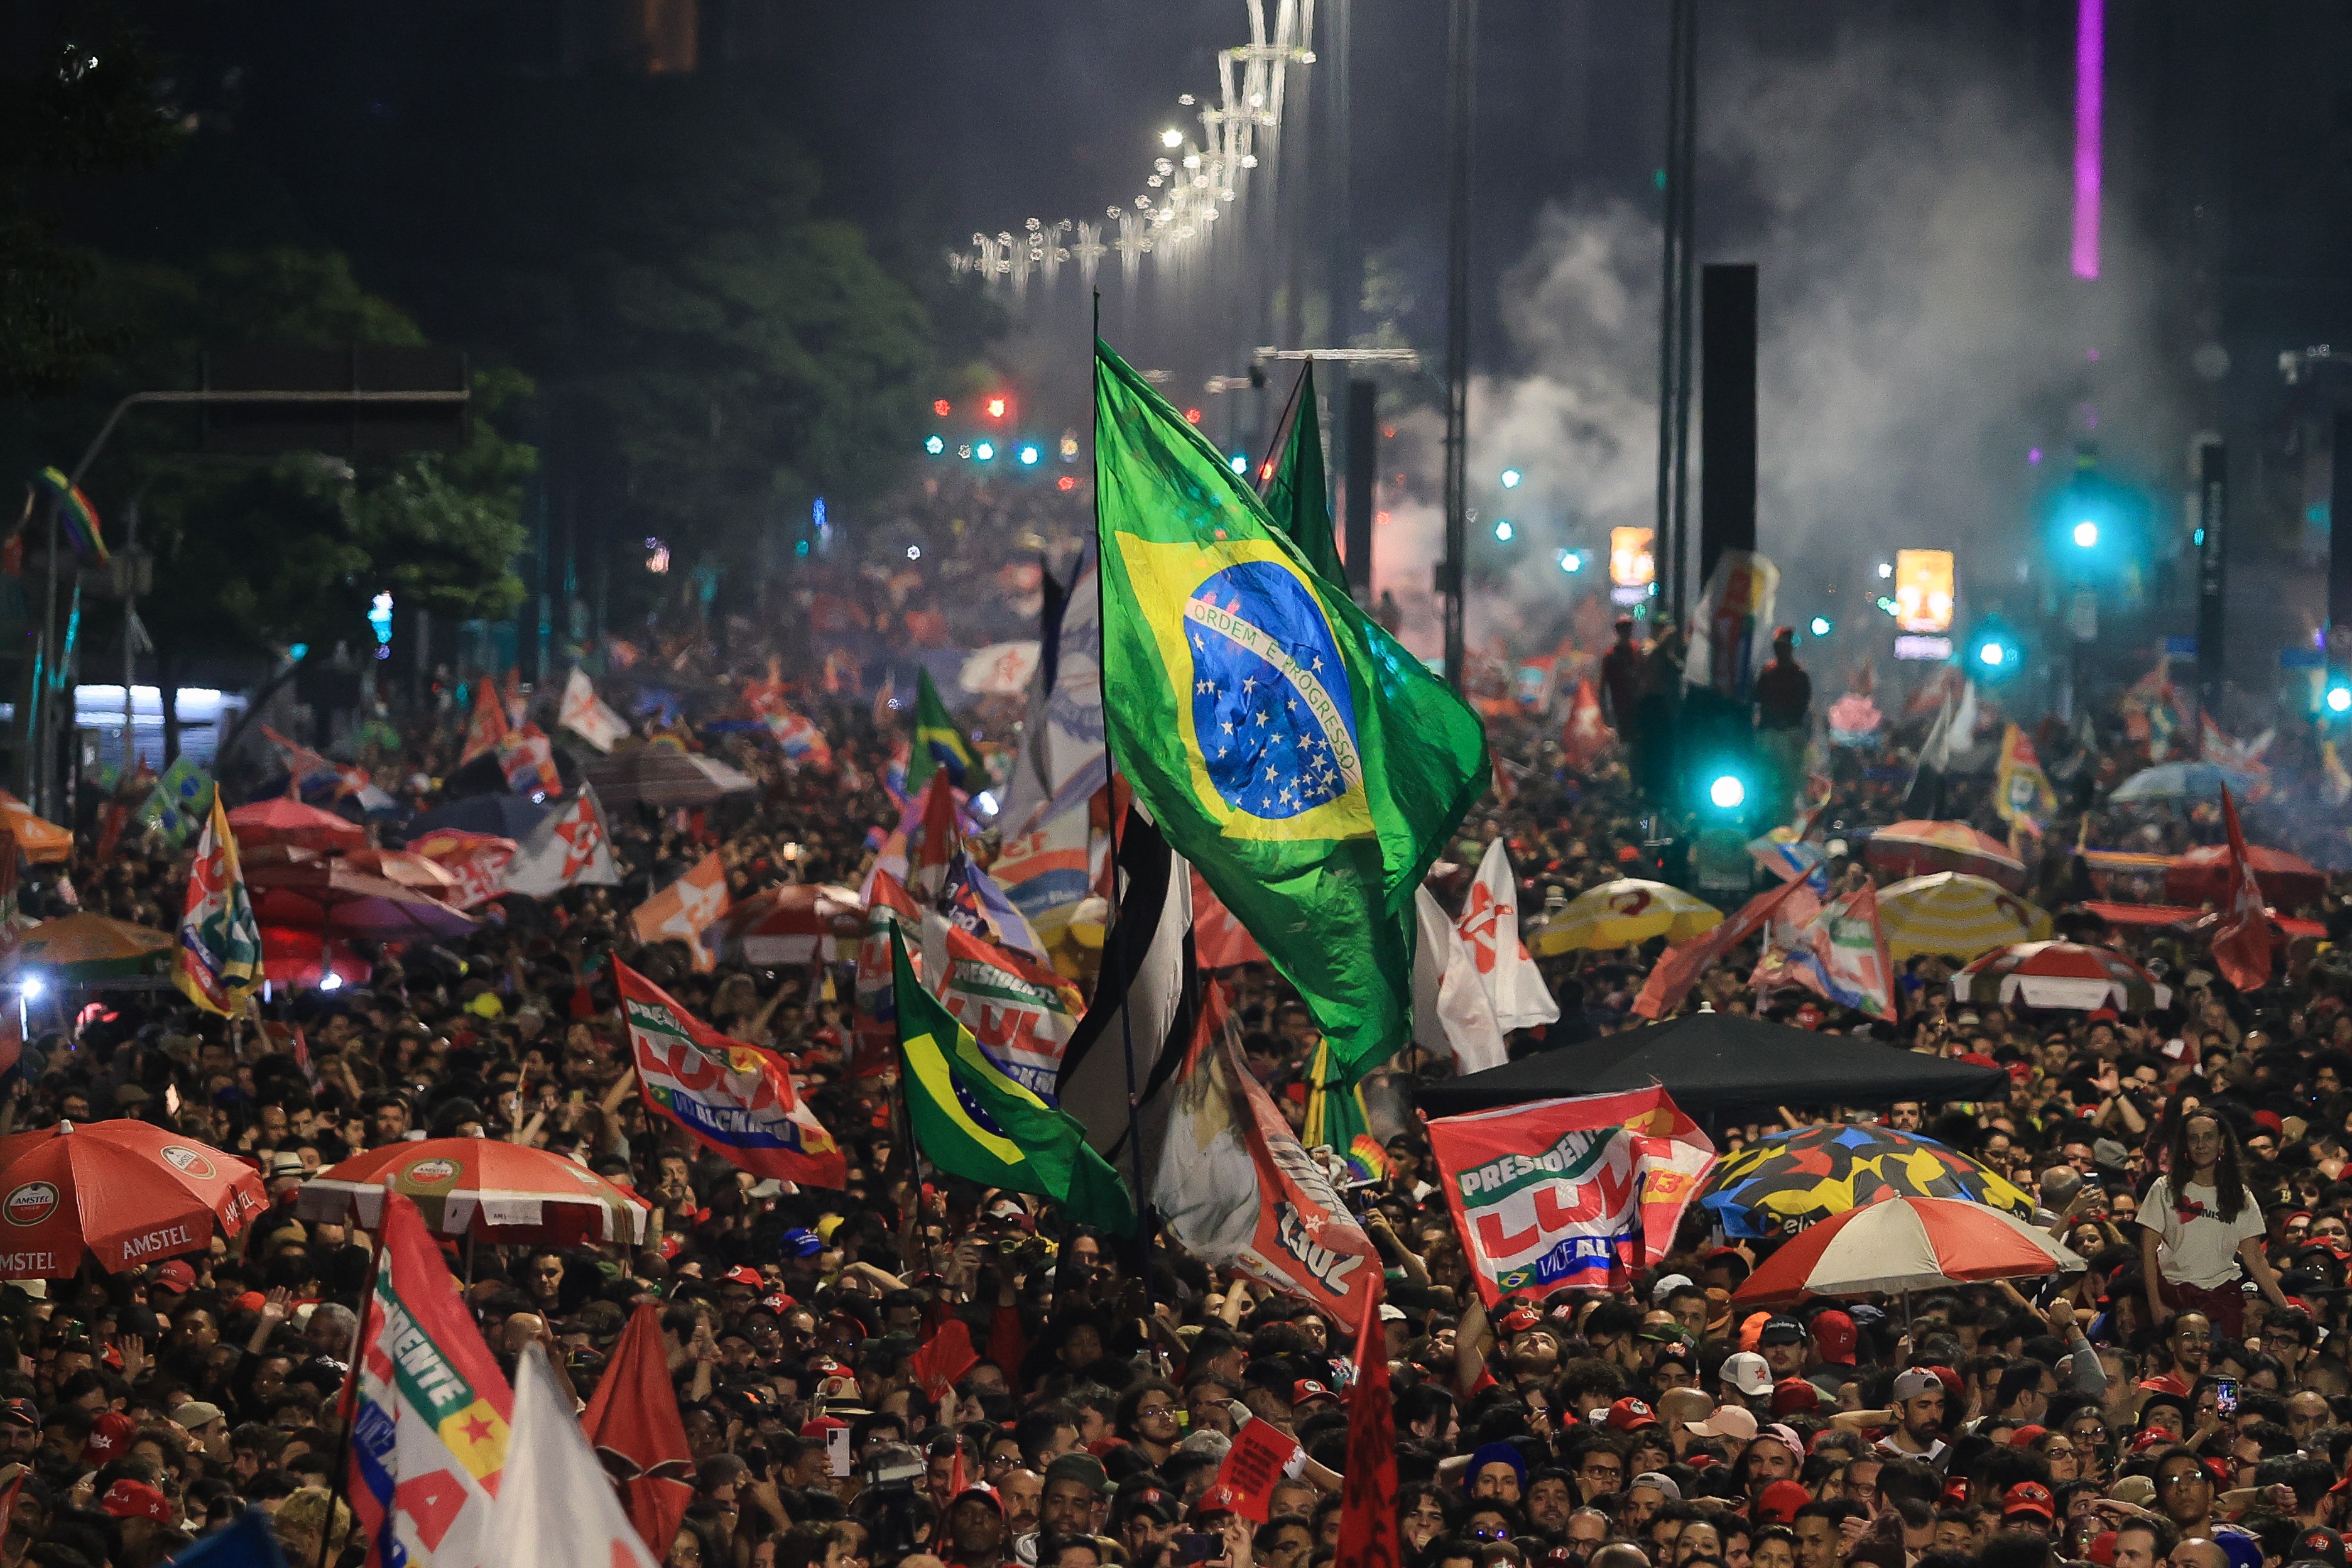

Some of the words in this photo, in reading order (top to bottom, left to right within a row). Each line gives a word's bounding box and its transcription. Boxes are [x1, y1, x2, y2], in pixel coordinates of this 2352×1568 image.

[1194, 604, 1256, 646] ORDEM
[1266, 641, 1280, 659] E
[1282, 657, 1355, 770] PROGRESSO
[944, 998, 1065, 1060] LUL
[1646, 1170, 1684, 1193] 13
[1476, 1159, 1640, 1258] LUL
[0, 1252, 56, 1271] MSTEL
[124, 1225, 192, 1260] AMSTEL
[1540, 1241, 1574, 1277] VICE
[1576, 1238, 1616, 1258] AL
